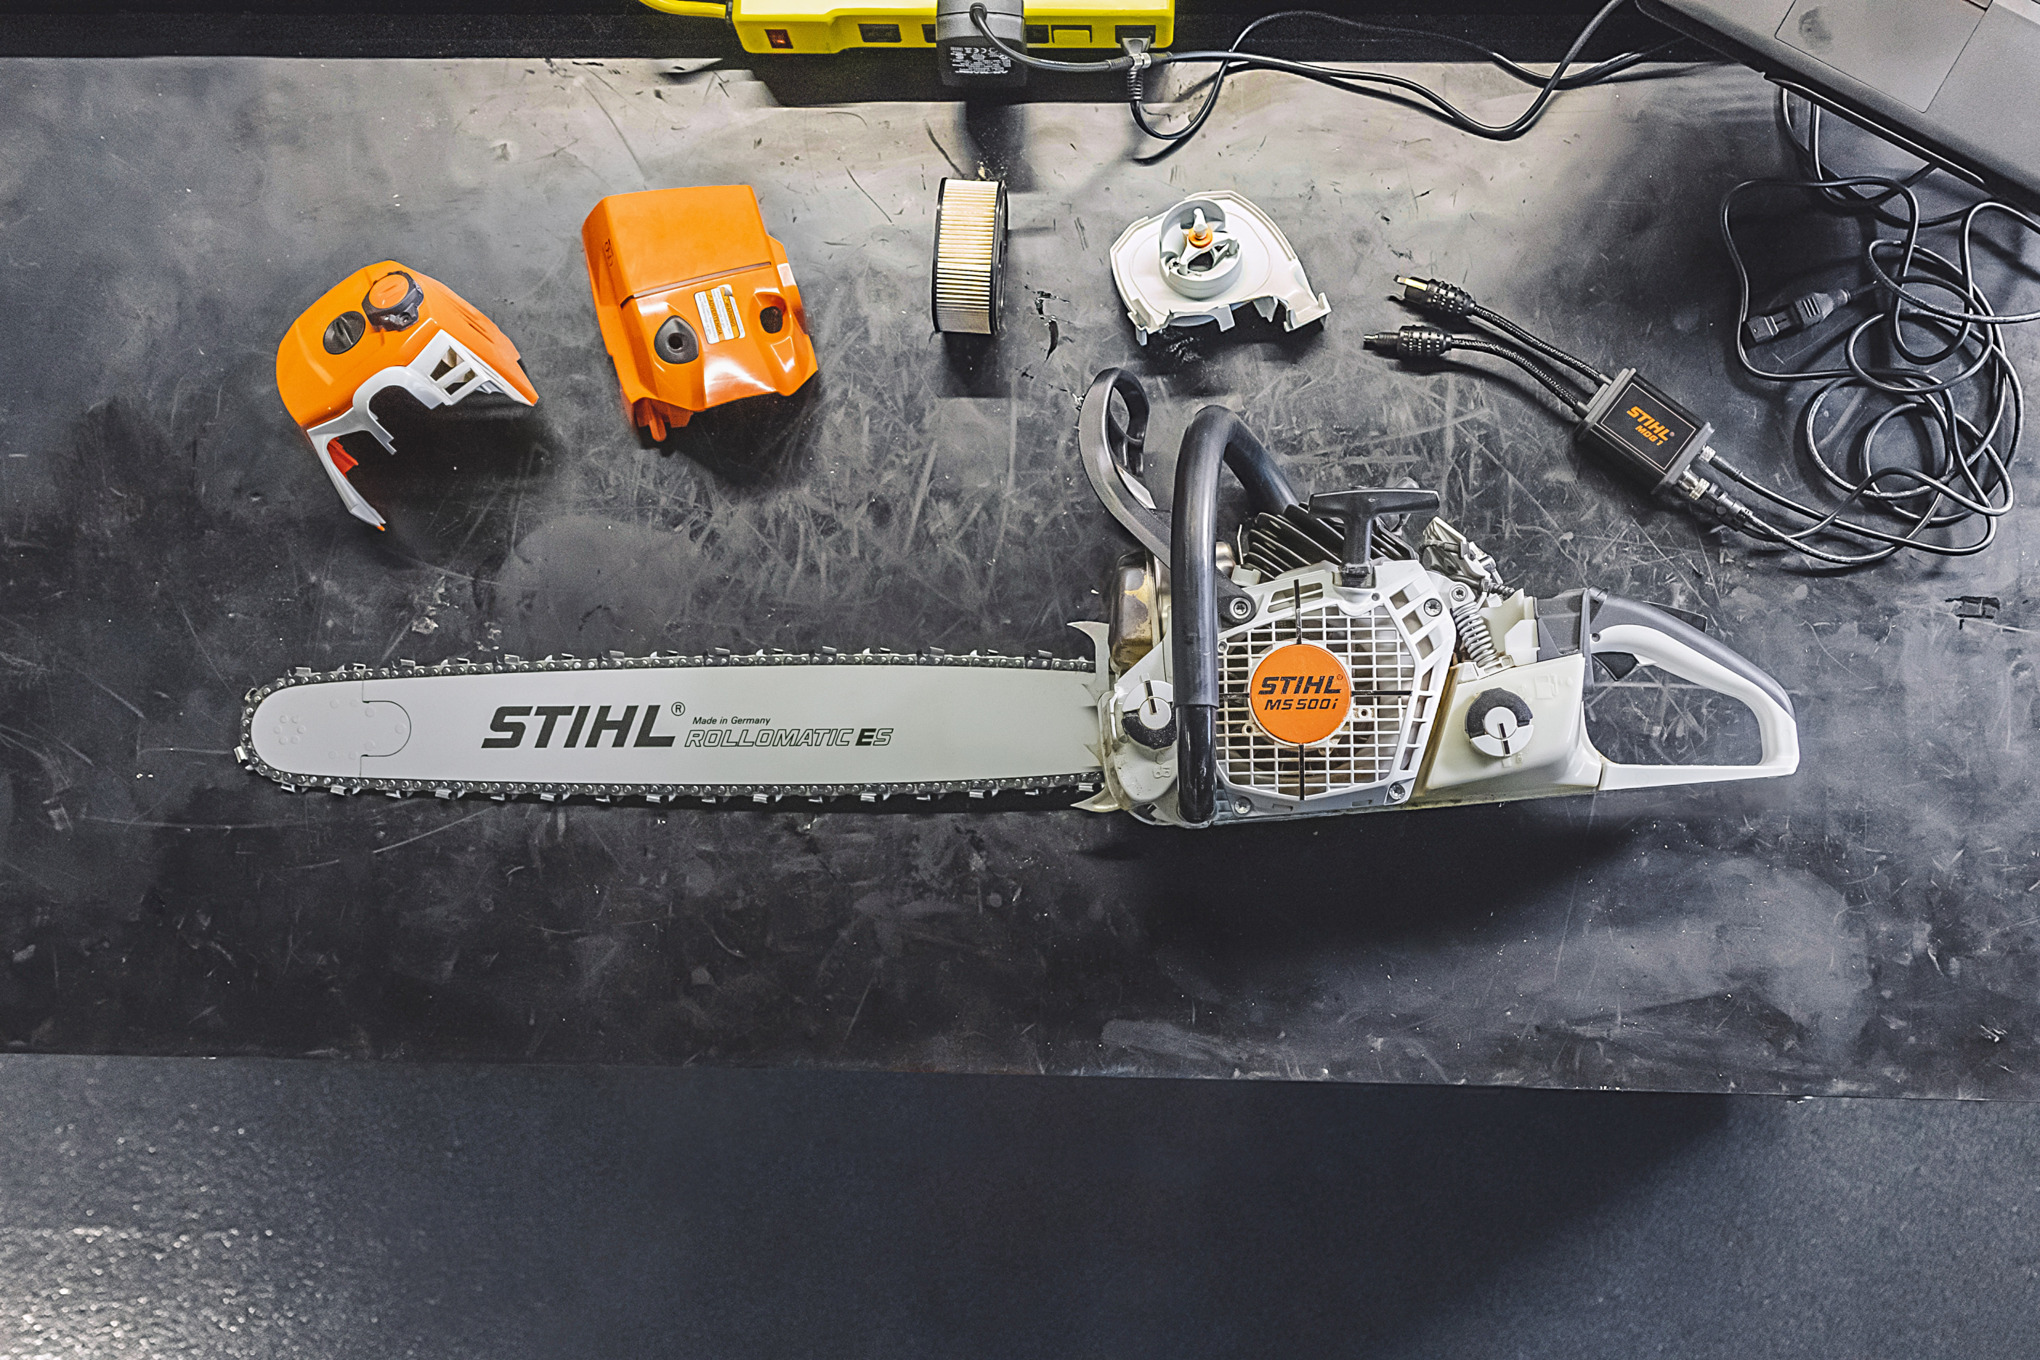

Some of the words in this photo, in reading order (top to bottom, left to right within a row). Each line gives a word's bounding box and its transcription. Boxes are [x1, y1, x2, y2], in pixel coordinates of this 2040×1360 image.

[708, 299, 722, 335] ADVERTENCIA
[1626, 405, 1670, 441] STIHL
[1258, 675, 1342, 695] STIHL
[1264, 699, 1293, 710] MS
[1295, 698, 1338, 710] 500i
[481, 704, 676, 748] STIHL
[692, 716, 717, 725] Made
[719, 716, 728, 725] in
[731, 716, 771, 726] Germany
[684, 728, 854, 748] ROLLOMATIC
[855, 728, 894, 746] ES
